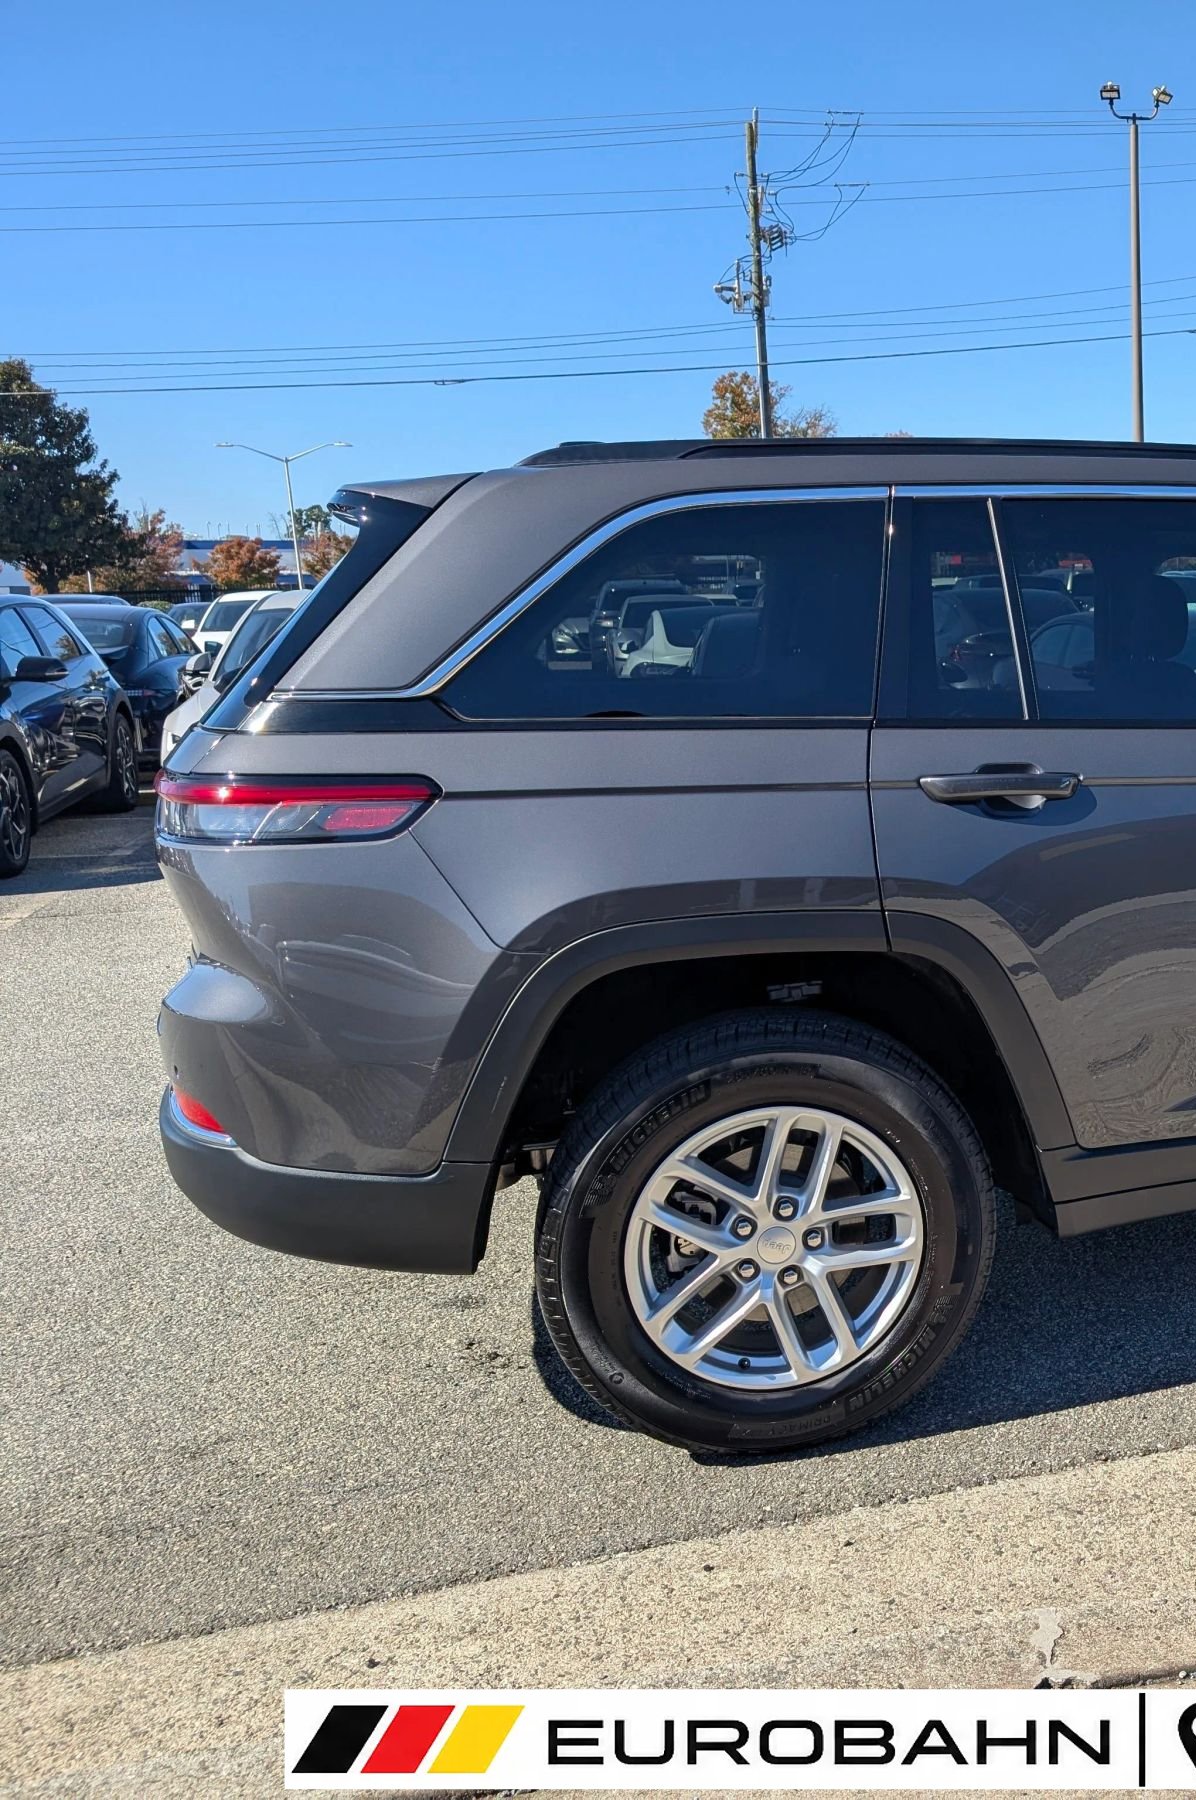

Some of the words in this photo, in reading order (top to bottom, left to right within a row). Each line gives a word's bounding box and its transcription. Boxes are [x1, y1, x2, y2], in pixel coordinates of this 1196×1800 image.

[608, 1081, 706, 1173] MICHELIN
[763, 1239, 792, 1255] Jeep
[849, 1326, 938, 1411] MICHELIN
